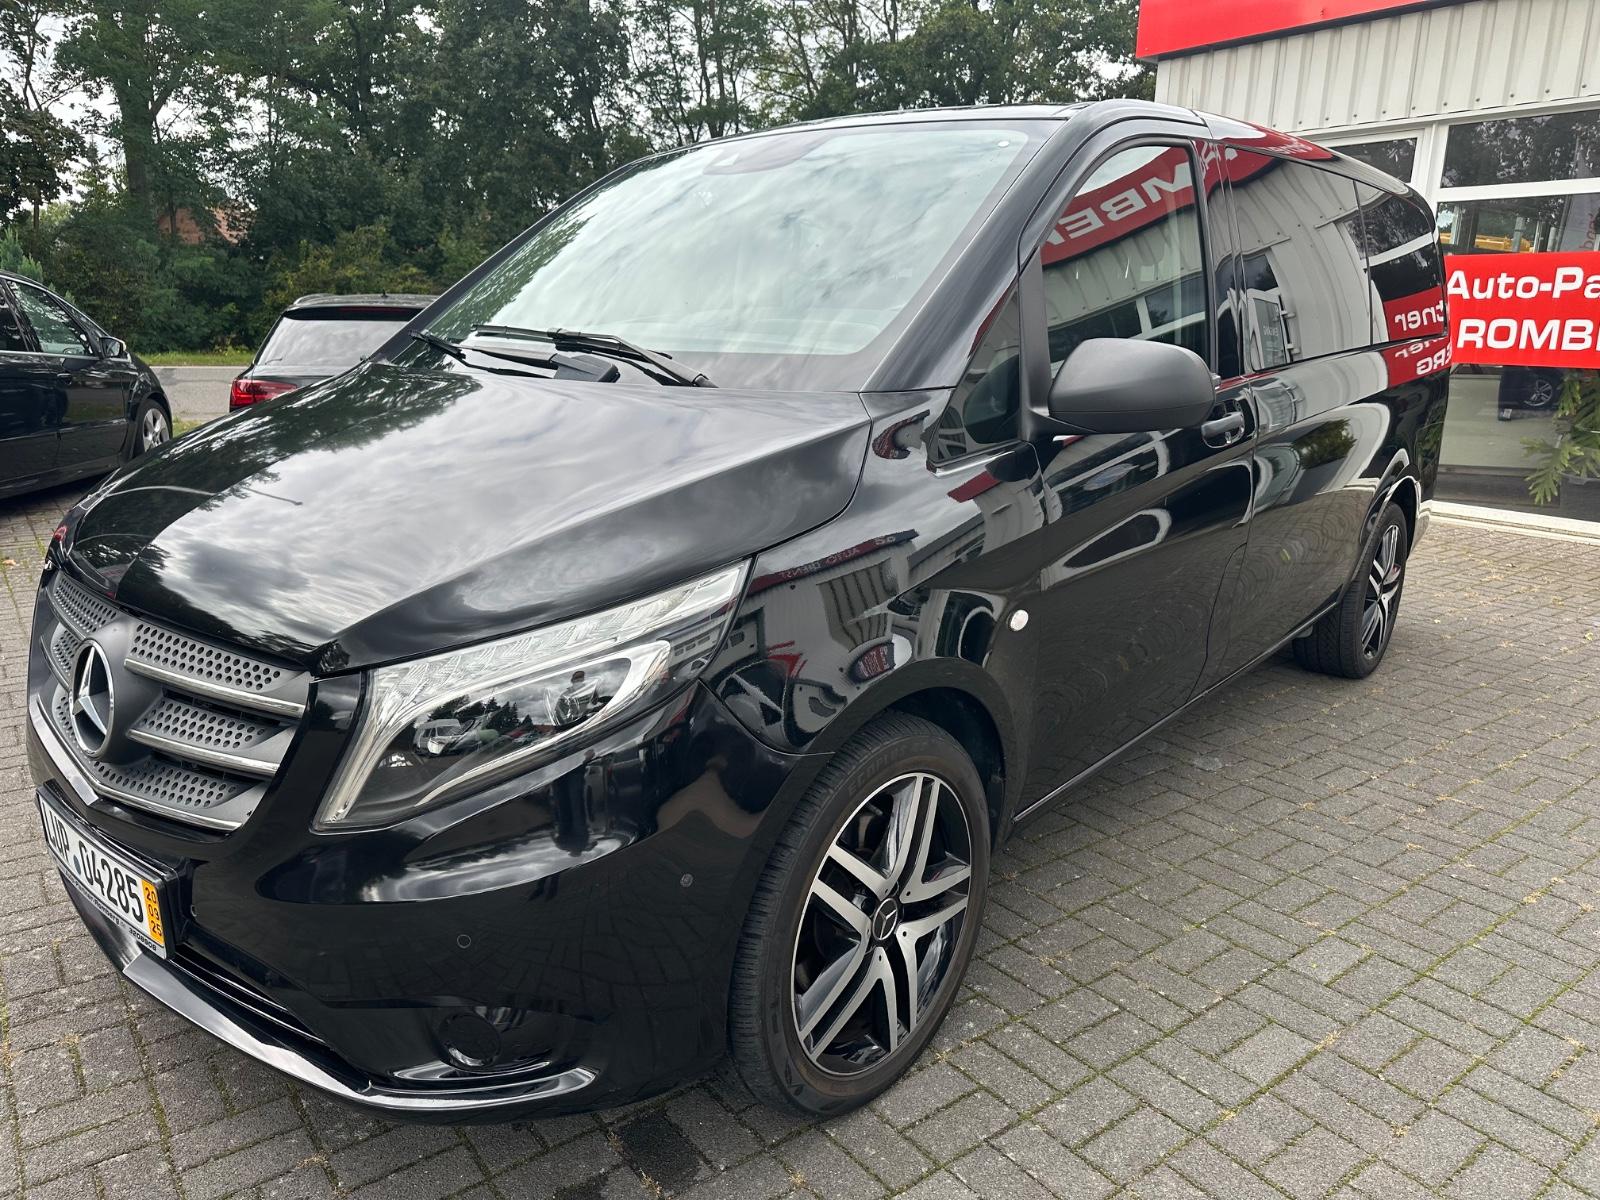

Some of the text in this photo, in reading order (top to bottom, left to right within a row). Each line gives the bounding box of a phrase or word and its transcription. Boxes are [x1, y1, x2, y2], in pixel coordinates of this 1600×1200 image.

[1456, 318, 1600, 351] ROMB
[42, 801, 70, 863] LUP
[79, 840, 144, 923] 04285
[145, 887, 157, 904] 20
[148, 904, 160, 921] 09
[151, 920, 162, 937] 25
